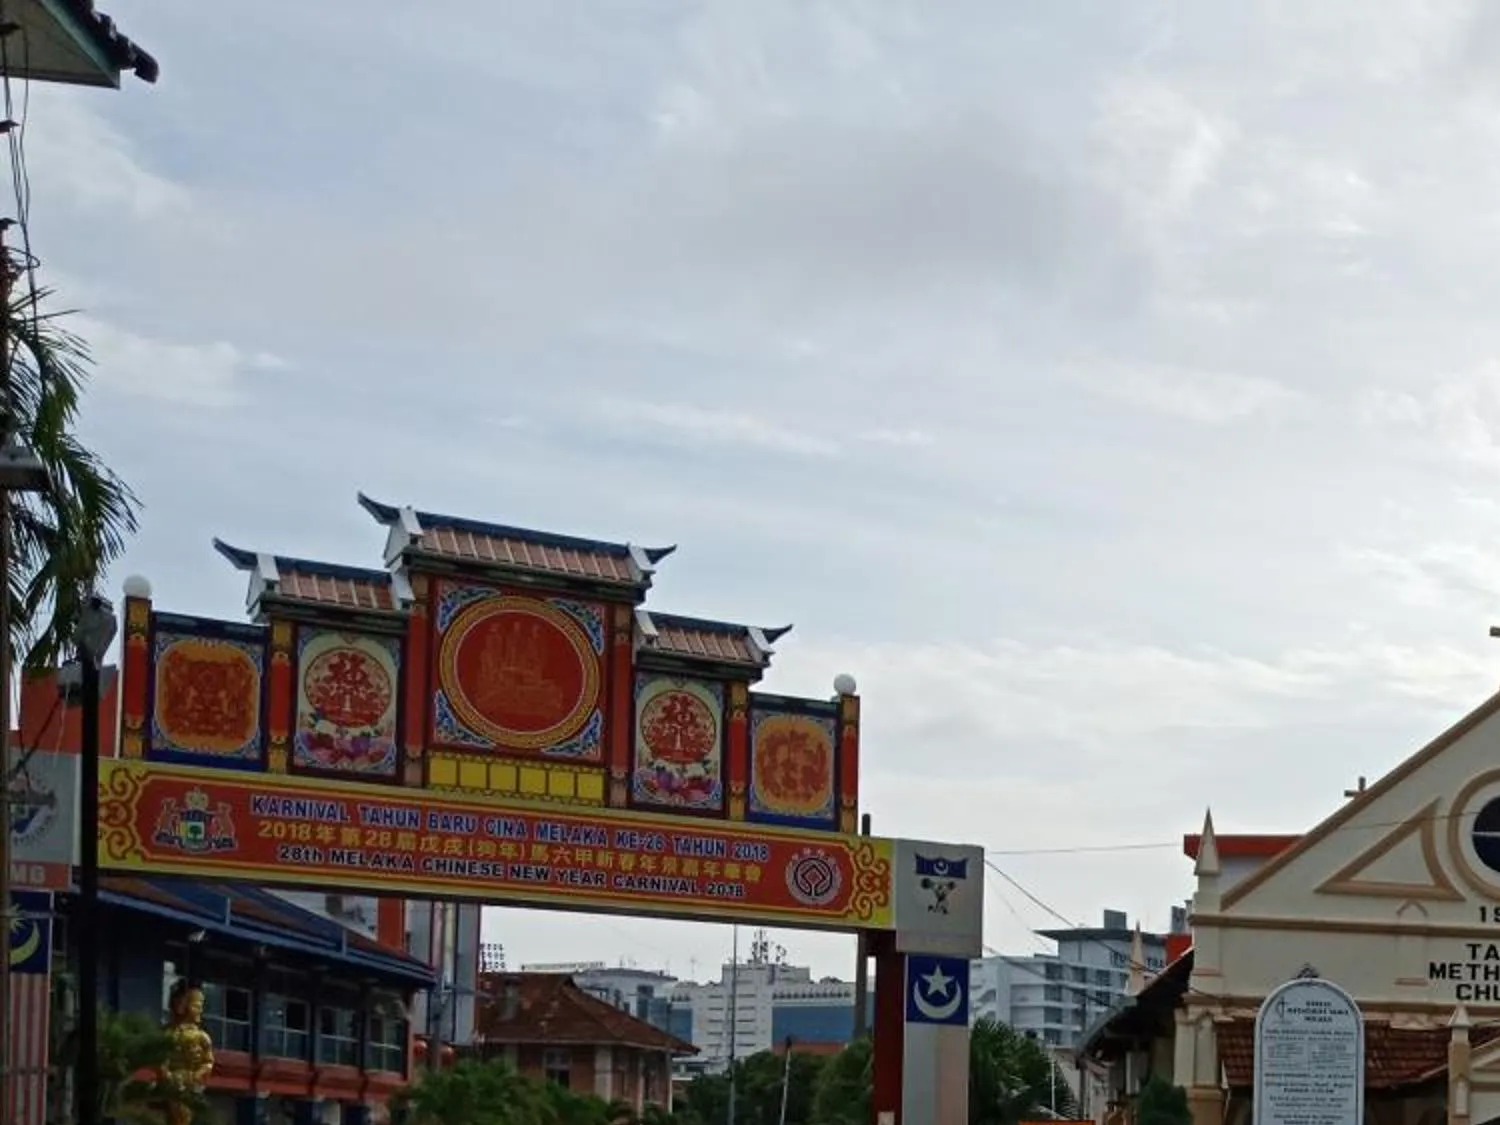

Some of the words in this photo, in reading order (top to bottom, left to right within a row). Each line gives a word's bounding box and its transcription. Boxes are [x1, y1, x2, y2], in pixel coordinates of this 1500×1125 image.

[251, 794, 350, 821] KARNIVAL
[358, 803, 422, 829] TAHUN
[427, 811, 478, 833] BARU
[483, 816, 528, 838] CINA
[534, 820, 609, 847] MELAKA
[672, 836, 727, 858] TAHUN
[732, 842, 770, 862] 2018
[278, 844, 323, 863] 28th
[328, 848, 415, 872] MELAKA
[421, 857, 503, 878] CHINESE
[508, 863, 551, 881] NEW
[555, 868, 606, 886] YEAR
[612, 873, 701, 895] CARNIVAL
[706, 882, 746, 898] 2018
